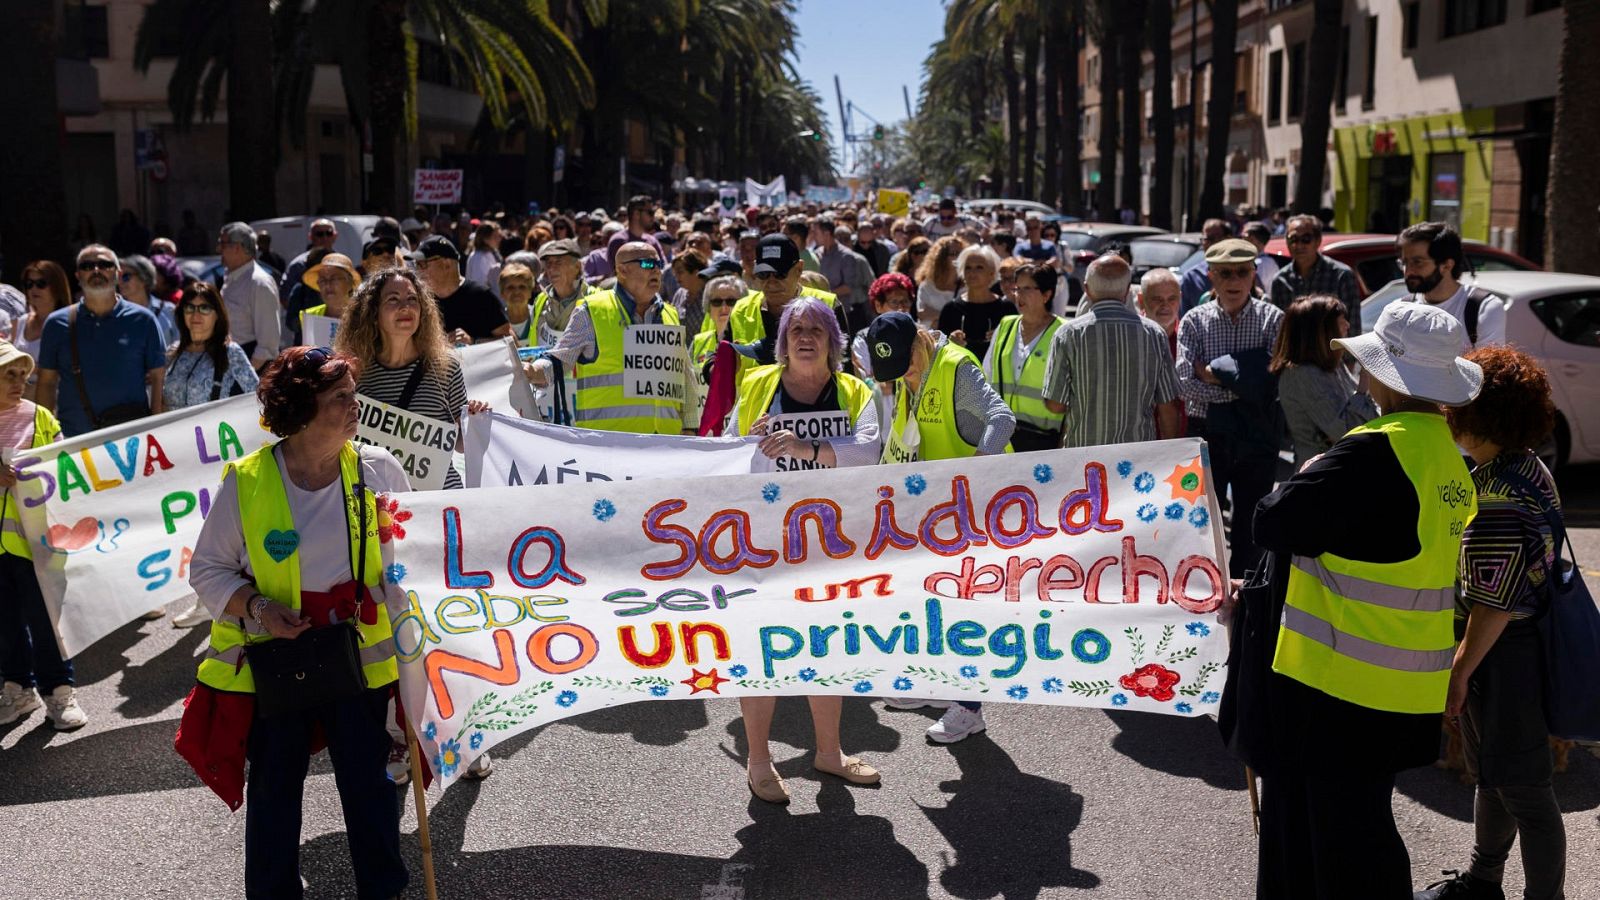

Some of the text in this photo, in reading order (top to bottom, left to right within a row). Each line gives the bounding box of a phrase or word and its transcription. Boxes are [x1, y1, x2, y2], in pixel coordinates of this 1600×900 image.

[624, 355, 684, 373] NEGOCIOS
[635, 330, 682, 346] NUNCA
[636, 380, 653, 396] LA
[15, 421, 244, 508] SALVA LA
[443, 461, 1123, 589] La Sanidad
[391, 535, 1224, 664] debe ser un derecho
[423, 598, 1112, 720] NO un privilegio
